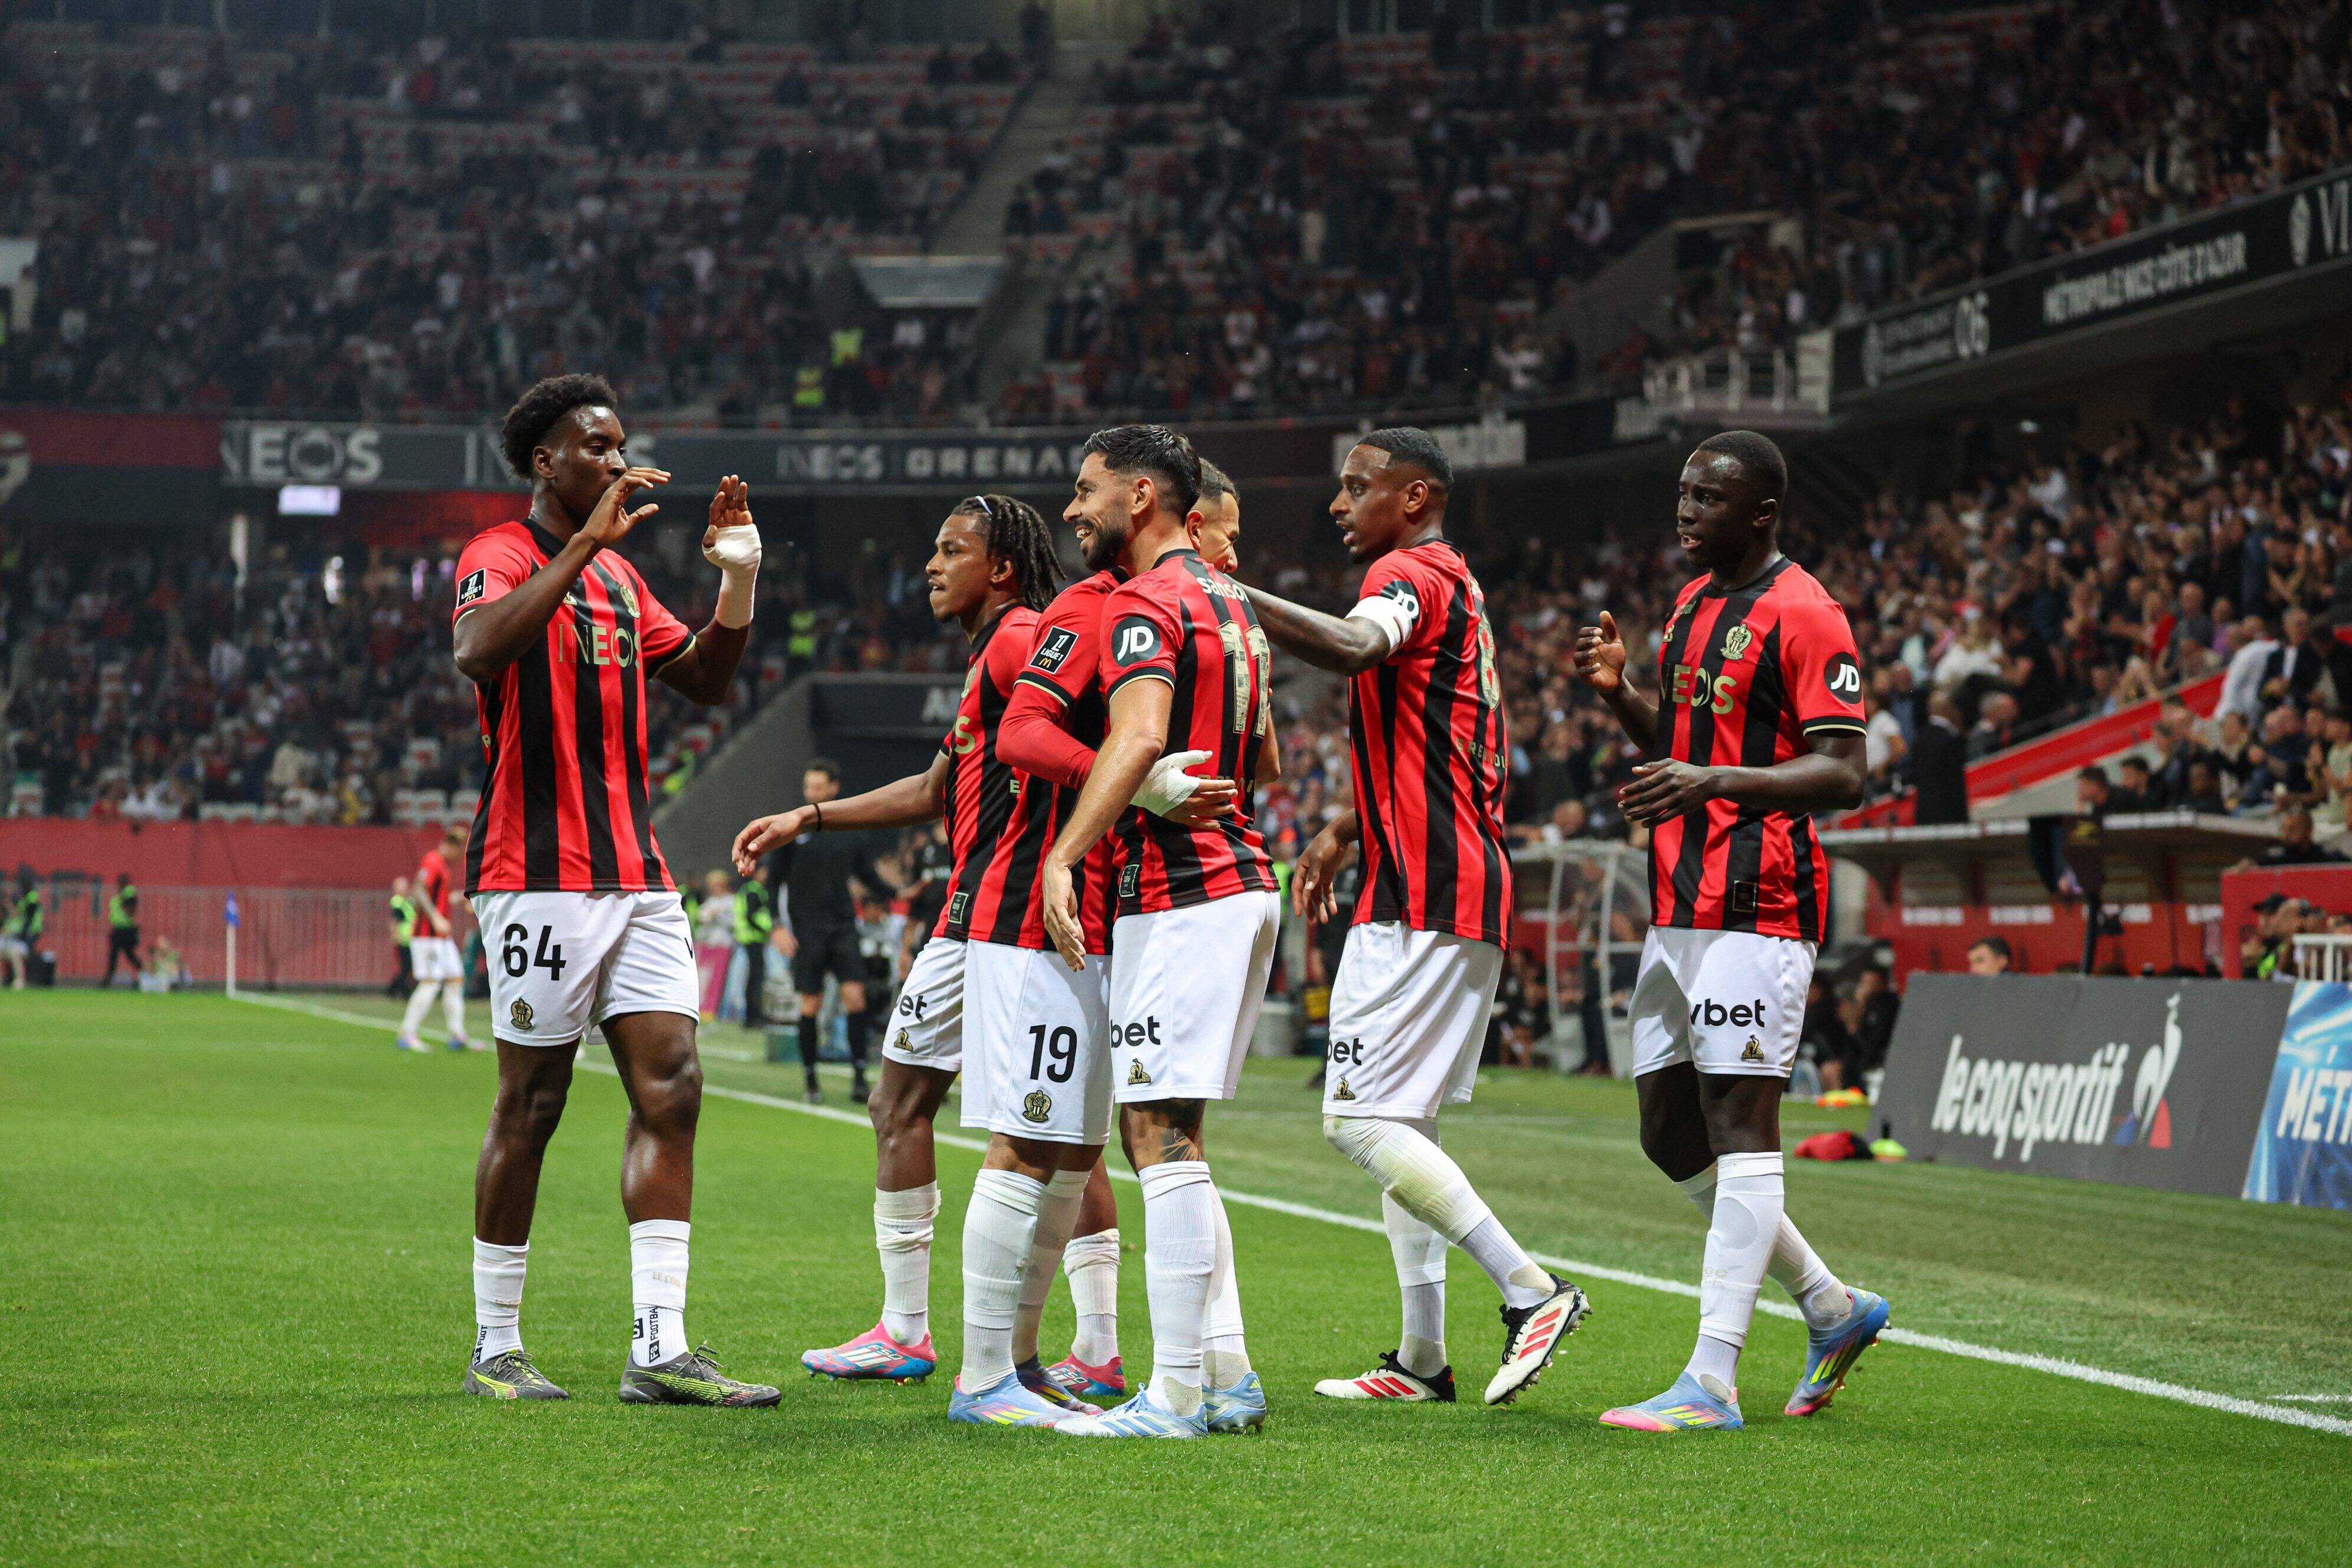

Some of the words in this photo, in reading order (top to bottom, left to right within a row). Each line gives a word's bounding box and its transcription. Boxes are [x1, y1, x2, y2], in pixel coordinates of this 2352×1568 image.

[1040, 648, 1061, 660] LIGUE
[1117, 626, 1154, 662] JD
[1216, 620, 1270, 739] 11
[1831, 663, 1860, 692] JD
[503, 923, 567, 981] 64
[896, 994, 927, 1023] et
[1029, 1024, 1077, 1083] 19
